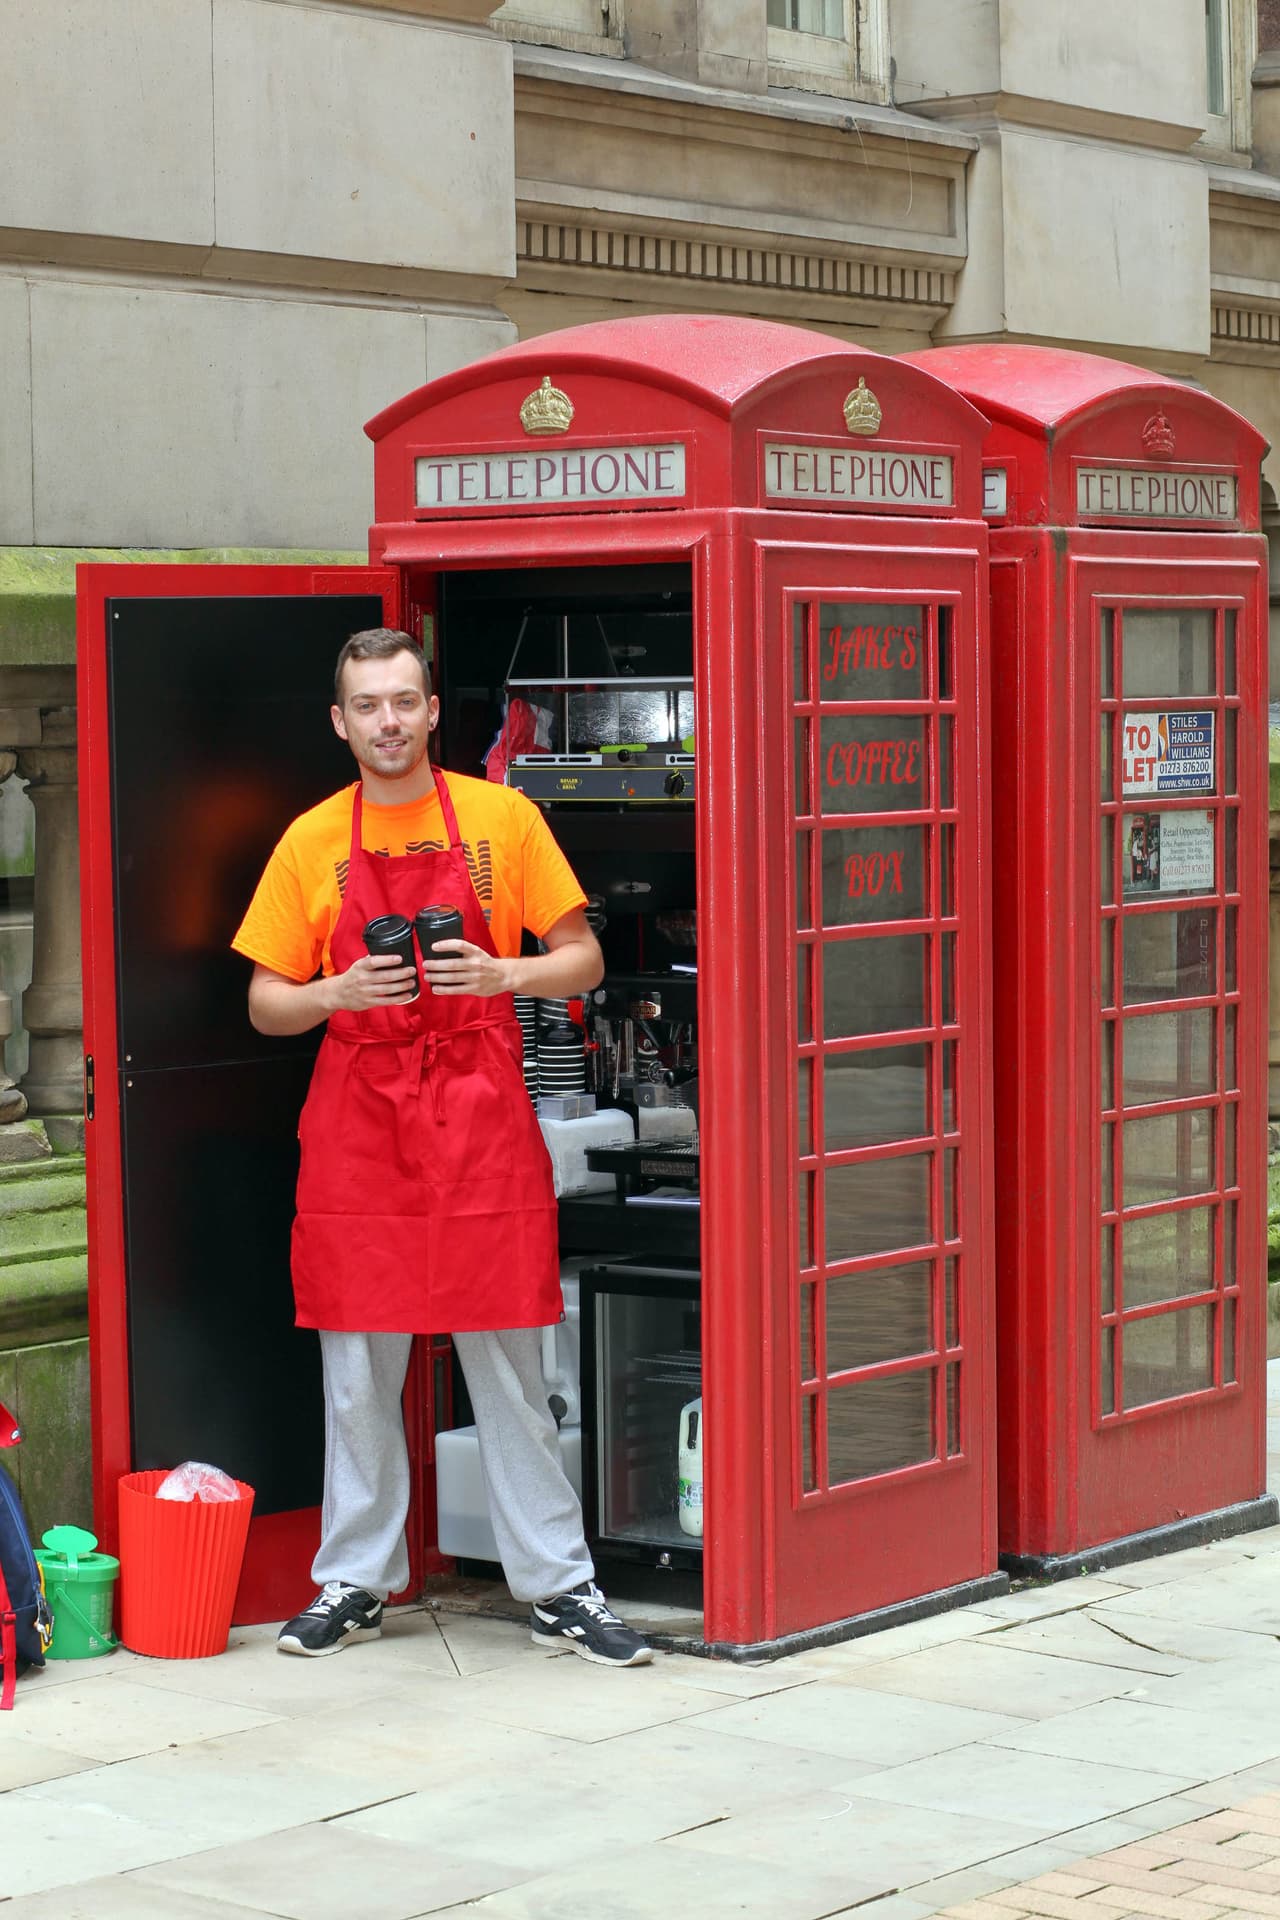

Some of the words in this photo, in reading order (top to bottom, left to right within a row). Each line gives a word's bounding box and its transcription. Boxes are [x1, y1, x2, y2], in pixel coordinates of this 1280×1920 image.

[427, 450, 676, 502] TELEPHONE
[770, 450, 945, 500] TELEPHONE
[1079, 473, 1228, 515] TELEPHONE
[823, 624, 917, 681] JAKE'S
[1171, 716, 1198, 729] STILES
[1125, 724, 1151, 752] TO
[1171, 731, 1204, 744] HAROLD
[826, 740, 921, 787] COFFEE
[1171, 746, 1210, 760] WILLIAMS
[1122, 756, 1157, 783] LET
[1159, 762, 1181, 775] 01273
[1182, 760, 1210, 773] 876200
[1158, 775, 1210, 789] www.shw.co.uk
[844, 850, 904, 897] BOX
